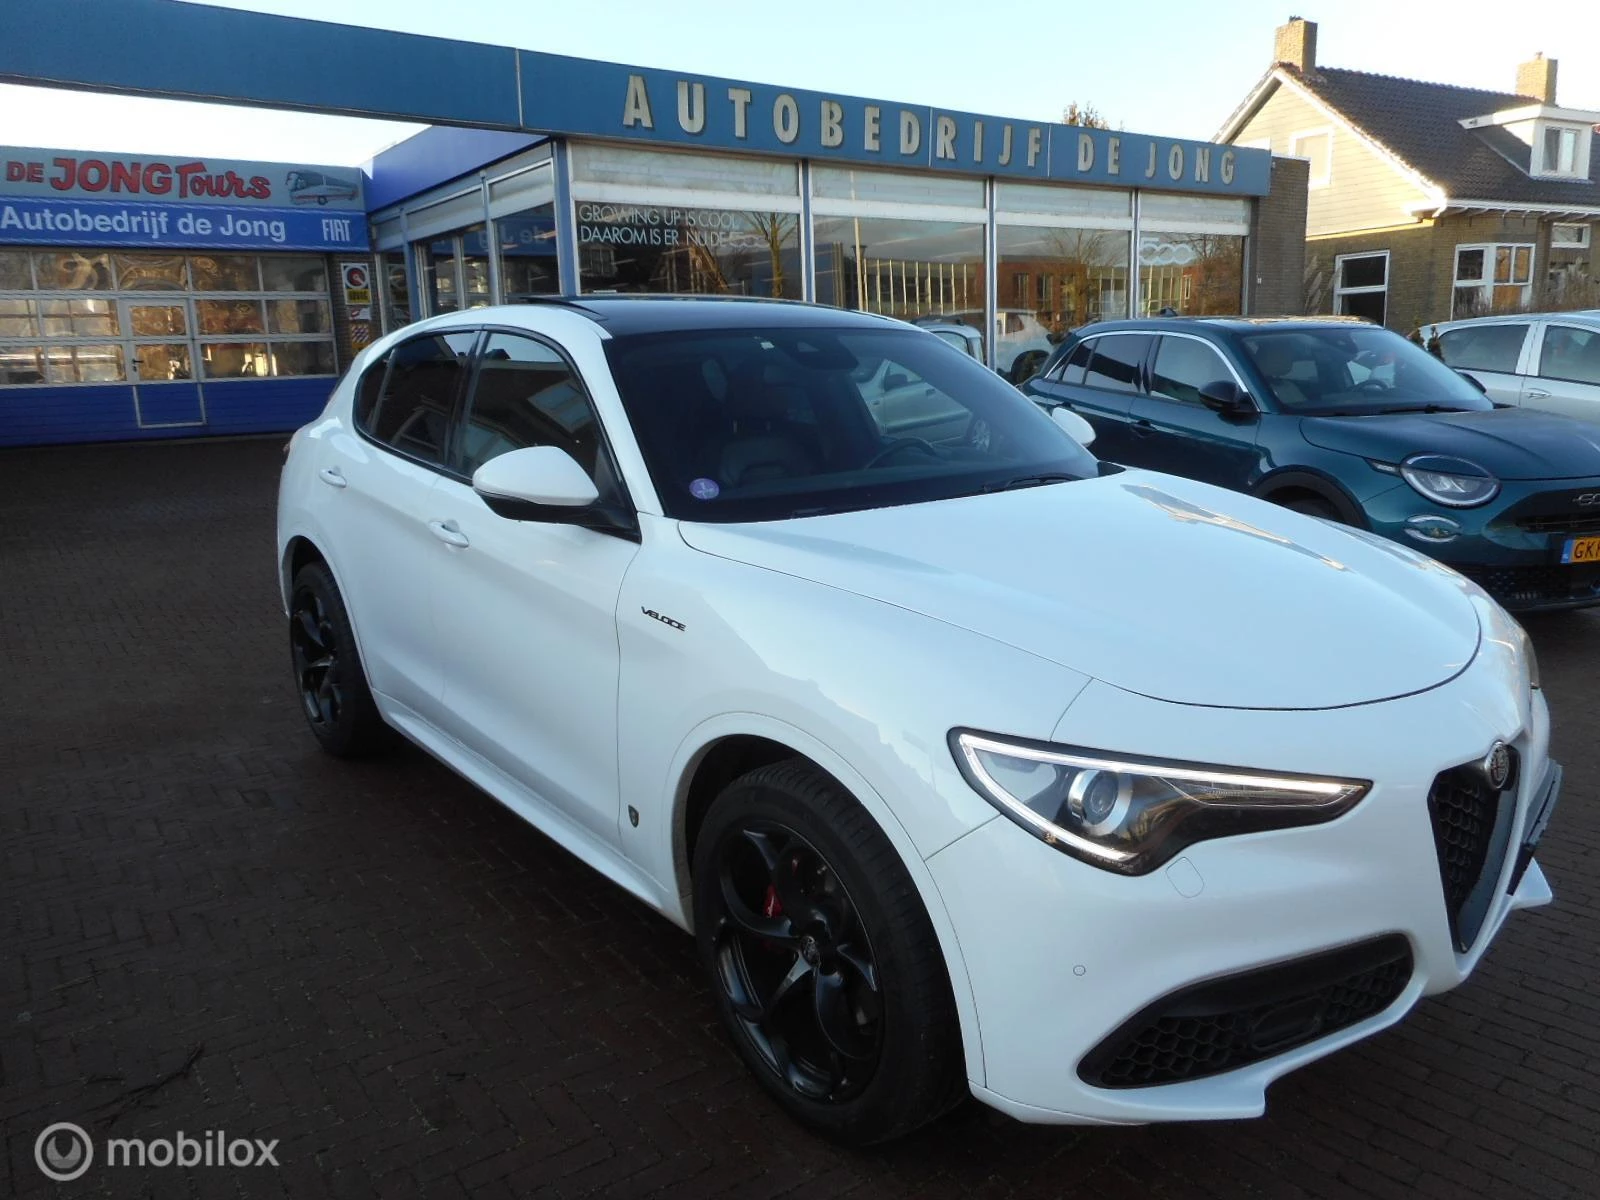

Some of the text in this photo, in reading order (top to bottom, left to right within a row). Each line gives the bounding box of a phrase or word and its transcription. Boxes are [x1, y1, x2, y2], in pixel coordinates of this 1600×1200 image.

[622, 74, 1235, 185] AUTOBEDRIJF DE JONG
[6, 157, 272, 200] DE JONG Tours
[0, 206, 286, 242] Autobedrijf de Jong
[578, 204, 660, 225] GROWING
[664, 212, 681, 225] UP
[684, 208, 697, 226] IS
[321, 218, 350, 241] FIAT
[580, 225, 647, 244] DAAROM
[650, 228, 661, 246] IS
[664, 229, 679, 246] ER
[641, 606, 686, 632] VELOCE
